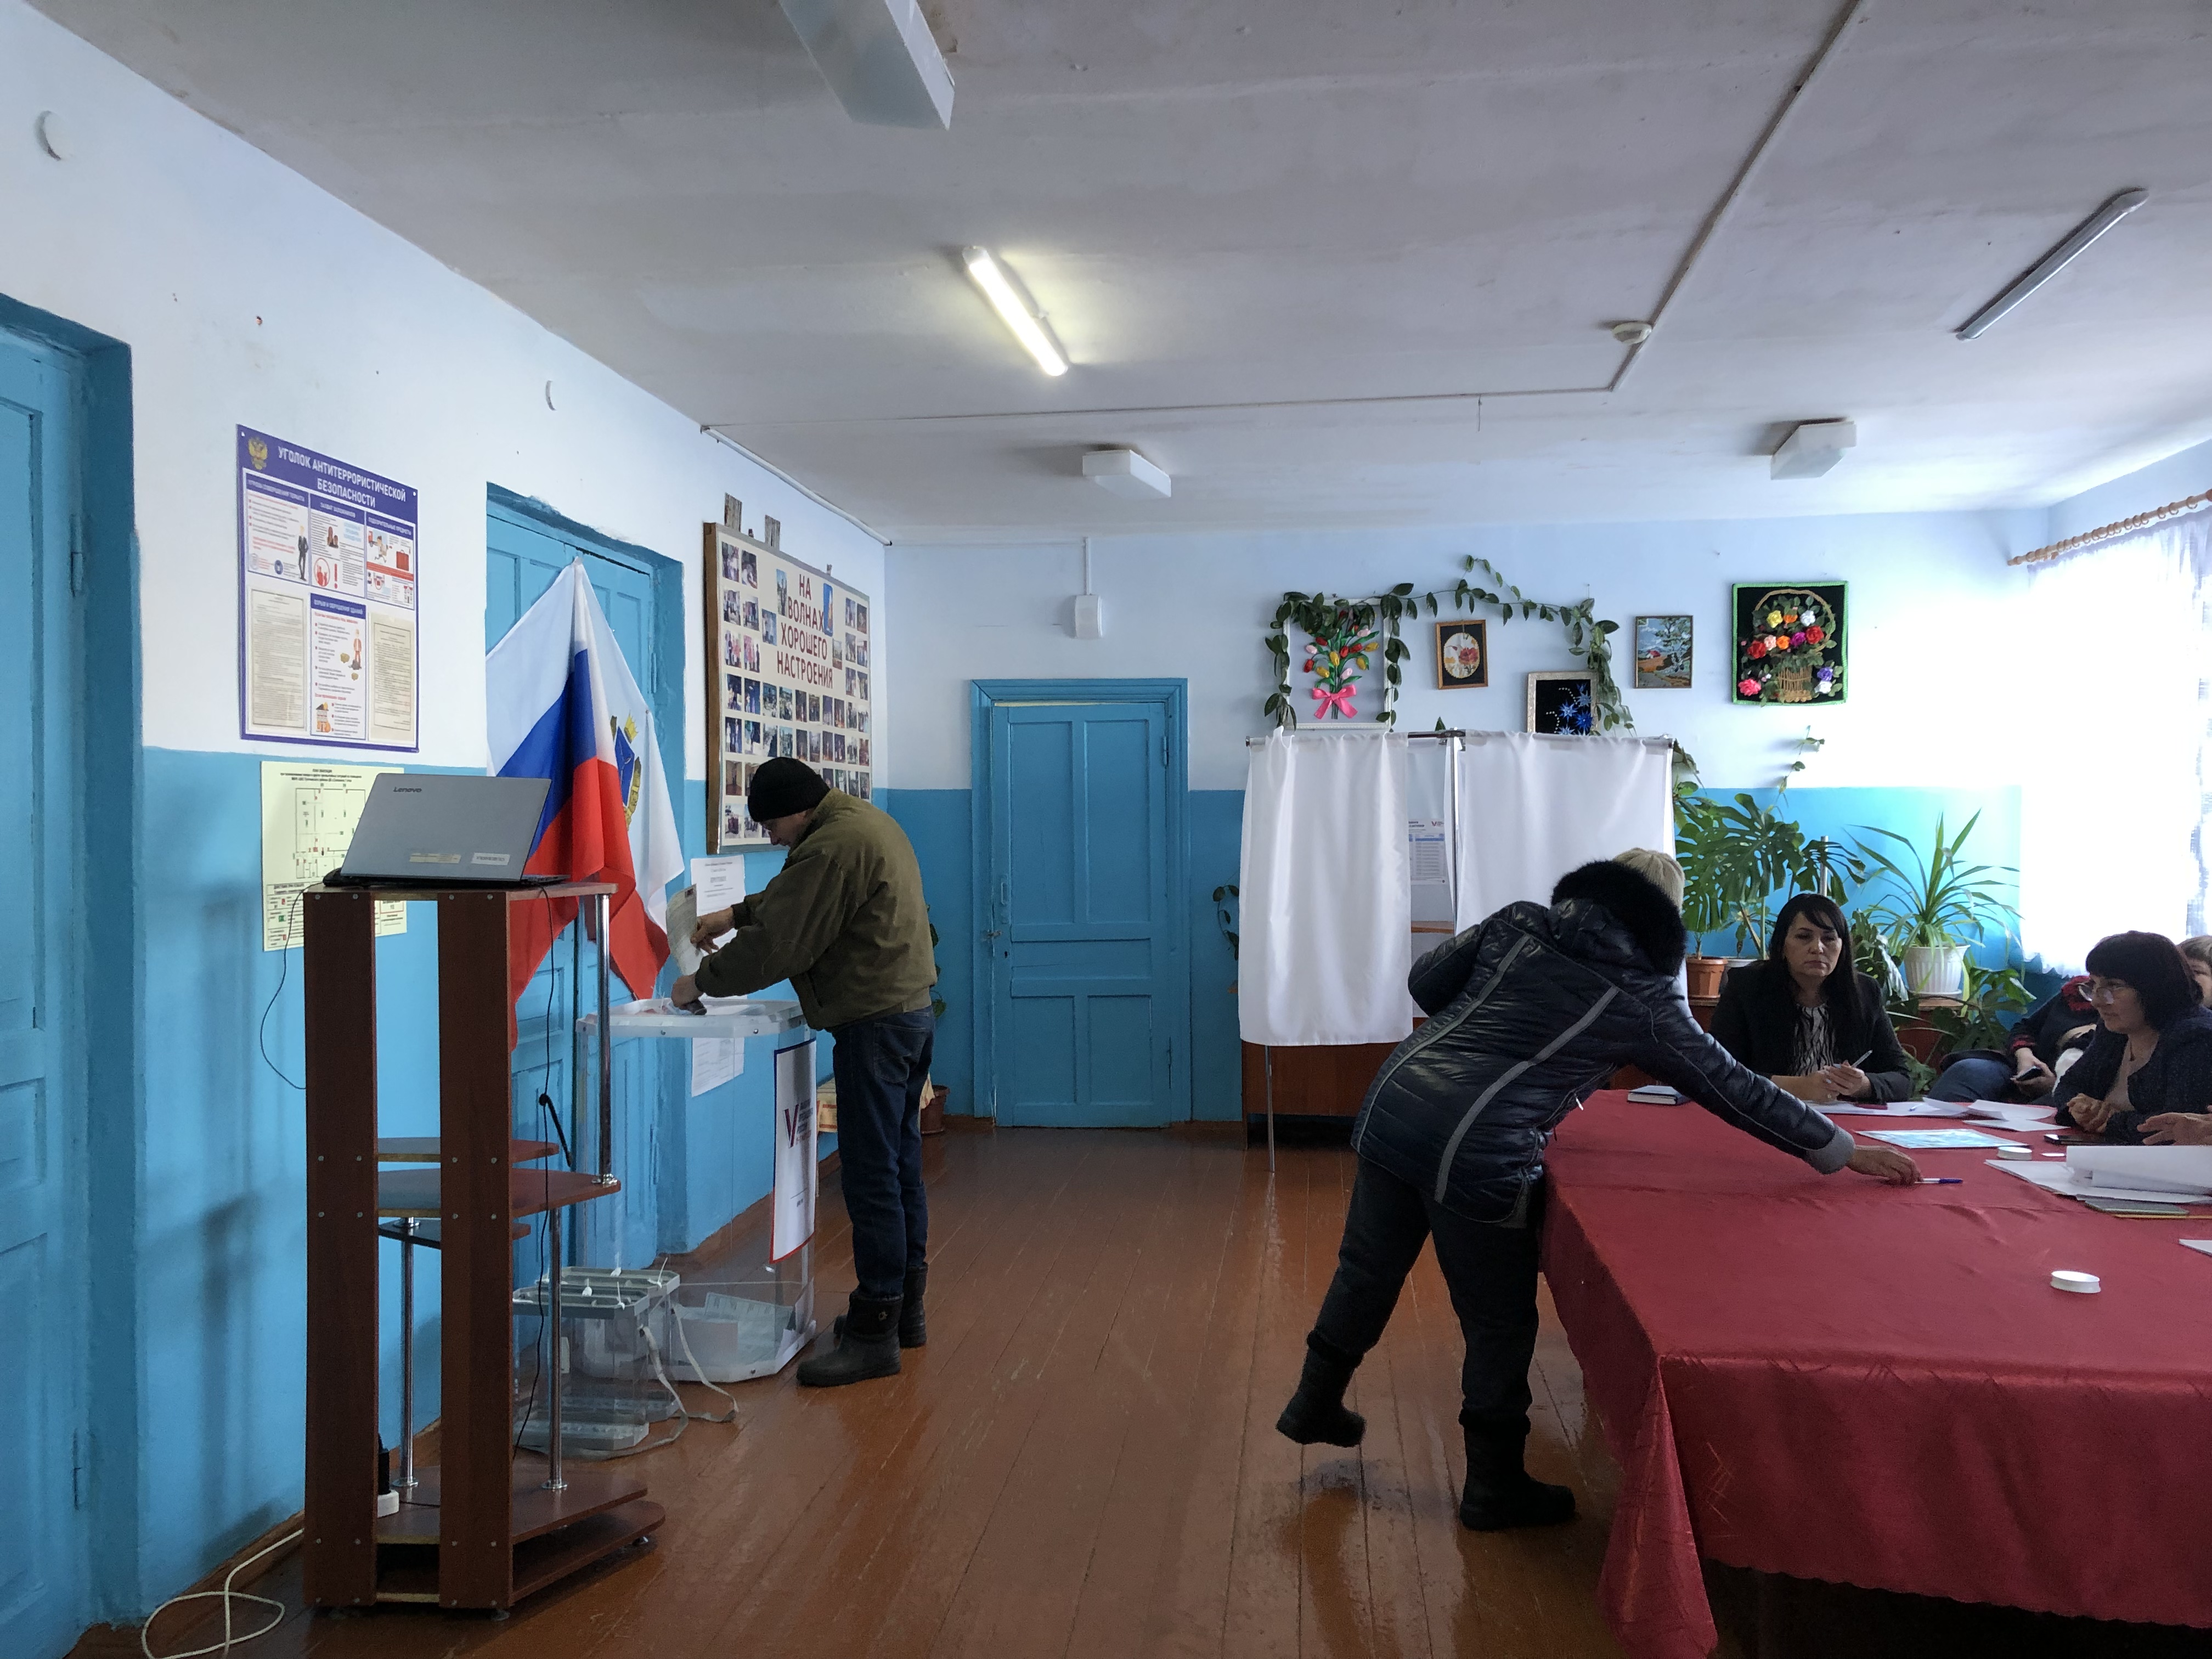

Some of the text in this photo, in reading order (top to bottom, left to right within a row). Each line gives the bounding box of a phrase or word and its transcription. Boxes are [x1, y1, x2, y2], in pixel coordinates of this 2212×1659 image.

[278, 446, 311, 469] УГОЛОК
[313, 459, 406, 502] АНТИТЕРРОРИСТИЧЕСКОЙ
[317, 478, 376, 507] БЕЗОПАСНОСТИ
[799, 574, 811, 600] НА
[788, 596, 824, 631] ВОЛНАХ
[781, 622, 827, 660] ХОРОШЕГО
[777, 651, 833, 689] НАСТРОЕНИЯ
